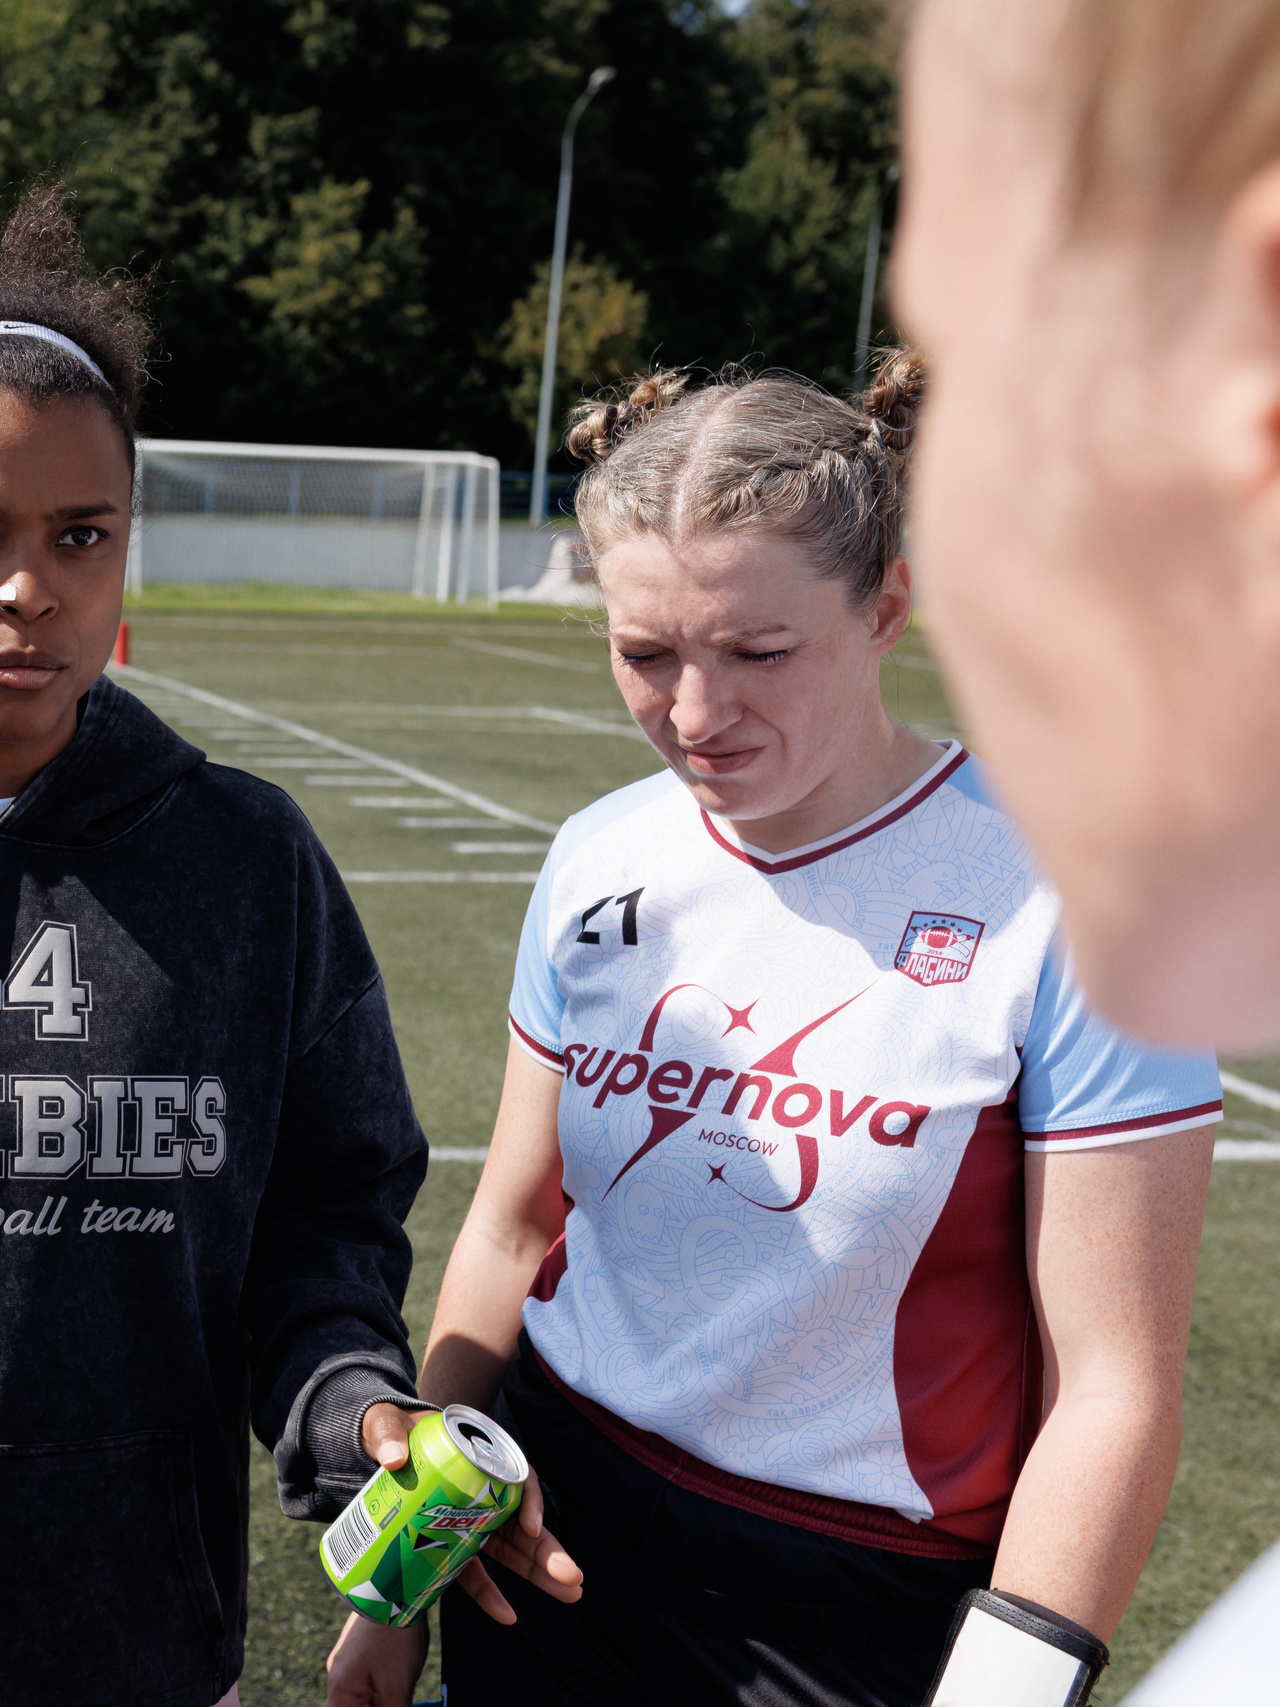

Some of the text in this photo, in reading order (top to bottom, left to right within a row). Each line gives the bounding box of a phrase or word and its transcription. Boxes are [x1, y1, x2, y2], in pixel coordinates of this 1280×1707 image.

[563, 1043, 931, 1148] supernova
[698, 1128, 780, 1156] MOSCOW
[81, 1199, 175, 1235] team
[429, 1507, 489, 1517] Mountain
